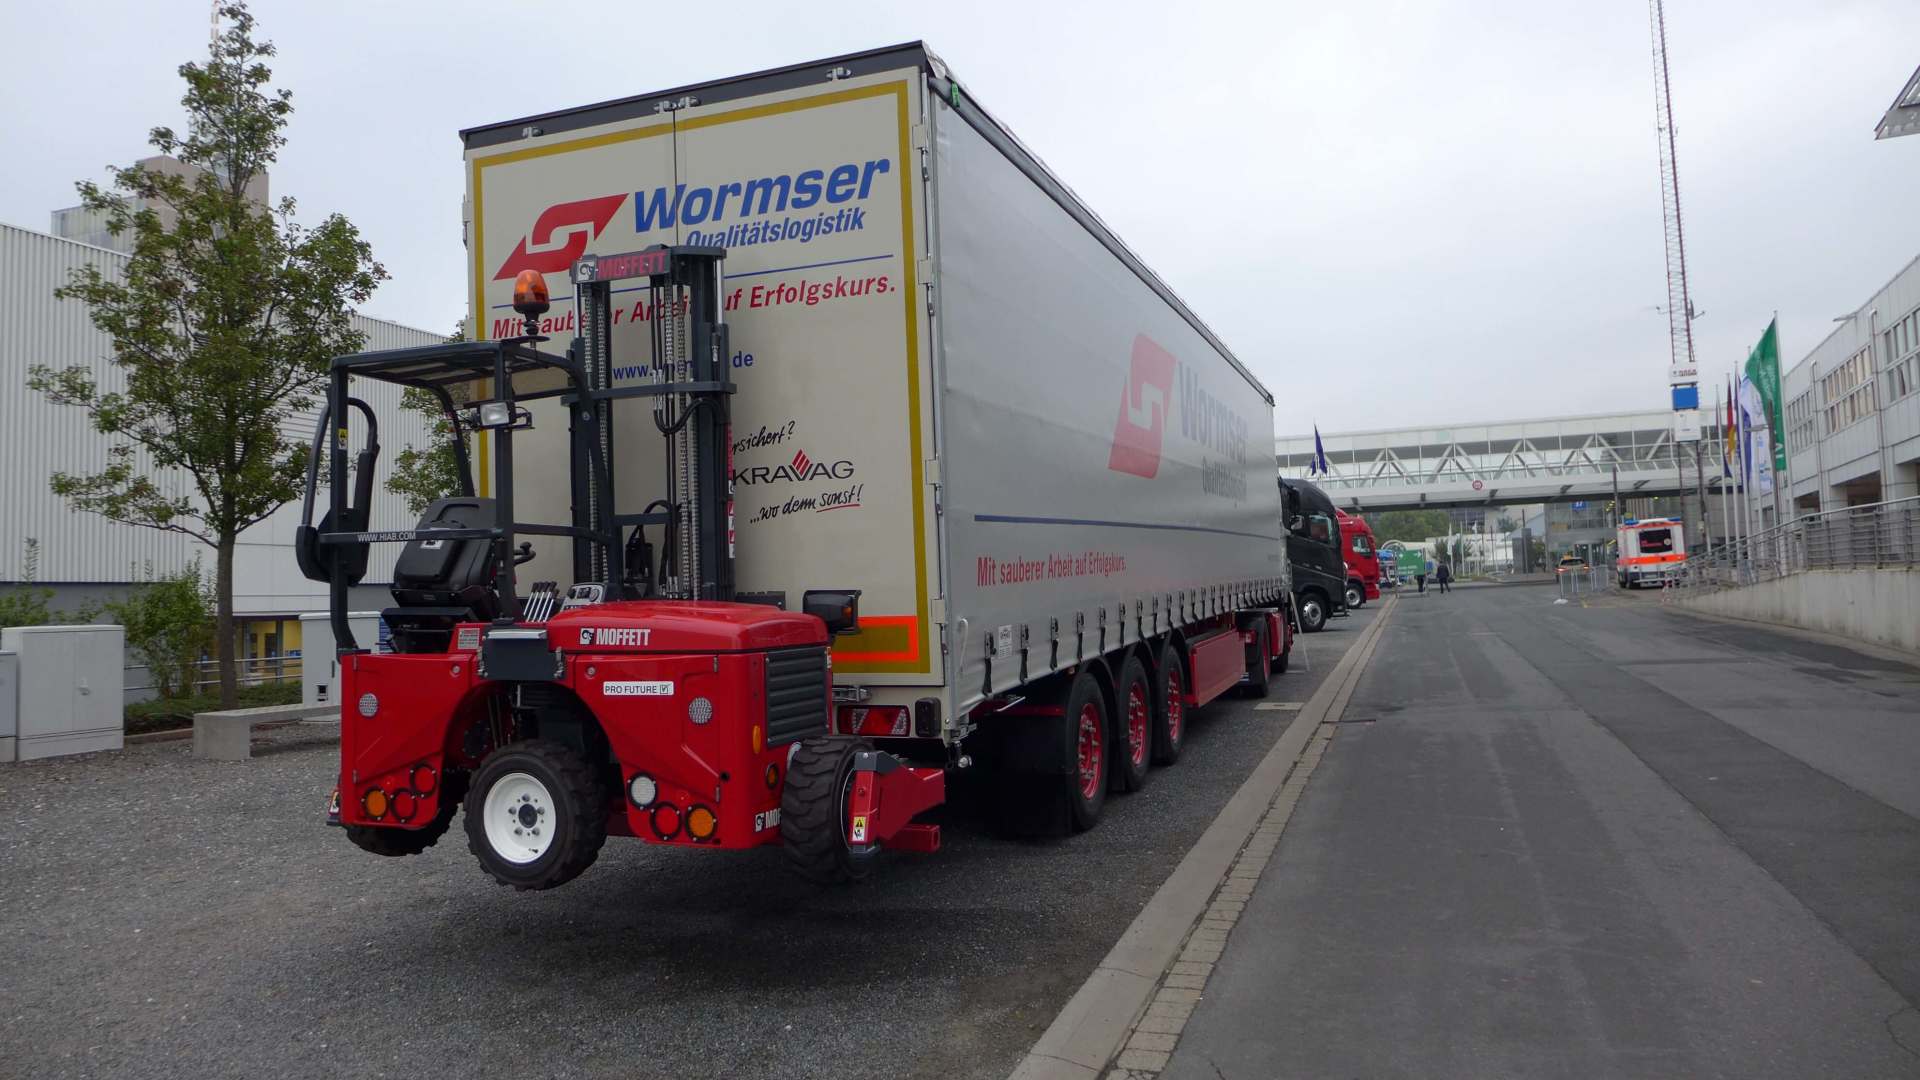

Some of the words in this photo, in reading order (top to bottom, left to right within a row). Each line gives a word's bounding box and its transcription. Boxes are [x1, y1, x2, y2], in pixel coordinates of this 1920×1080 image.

[635, 158, 890, 233] Wormser
[686, 206, 866, 249] Qualitätslogistik
[596, 250, 666, 281] MOFFETT
[493, 317, 524, 339] Mit
[750, 276, 895, 309] Erfolgskurs.
[733, 459, 855, 486] KRAVAG
[820, 484, 864, 508] sonst!
[357, 531, 417, 543] WWW.HIAB.COM
[977, 556, 997, 587] Mit
[1000, 555, 1045, 584] sauberer
[1048, 553, 1074, 578] Arbeit
[1075, 552, 1087, 576] auf
[596, 628, 651, 646] MOFFETT
[605, 685, 623, 694] PRO
[624, 685, 657, 694] FUTURE
